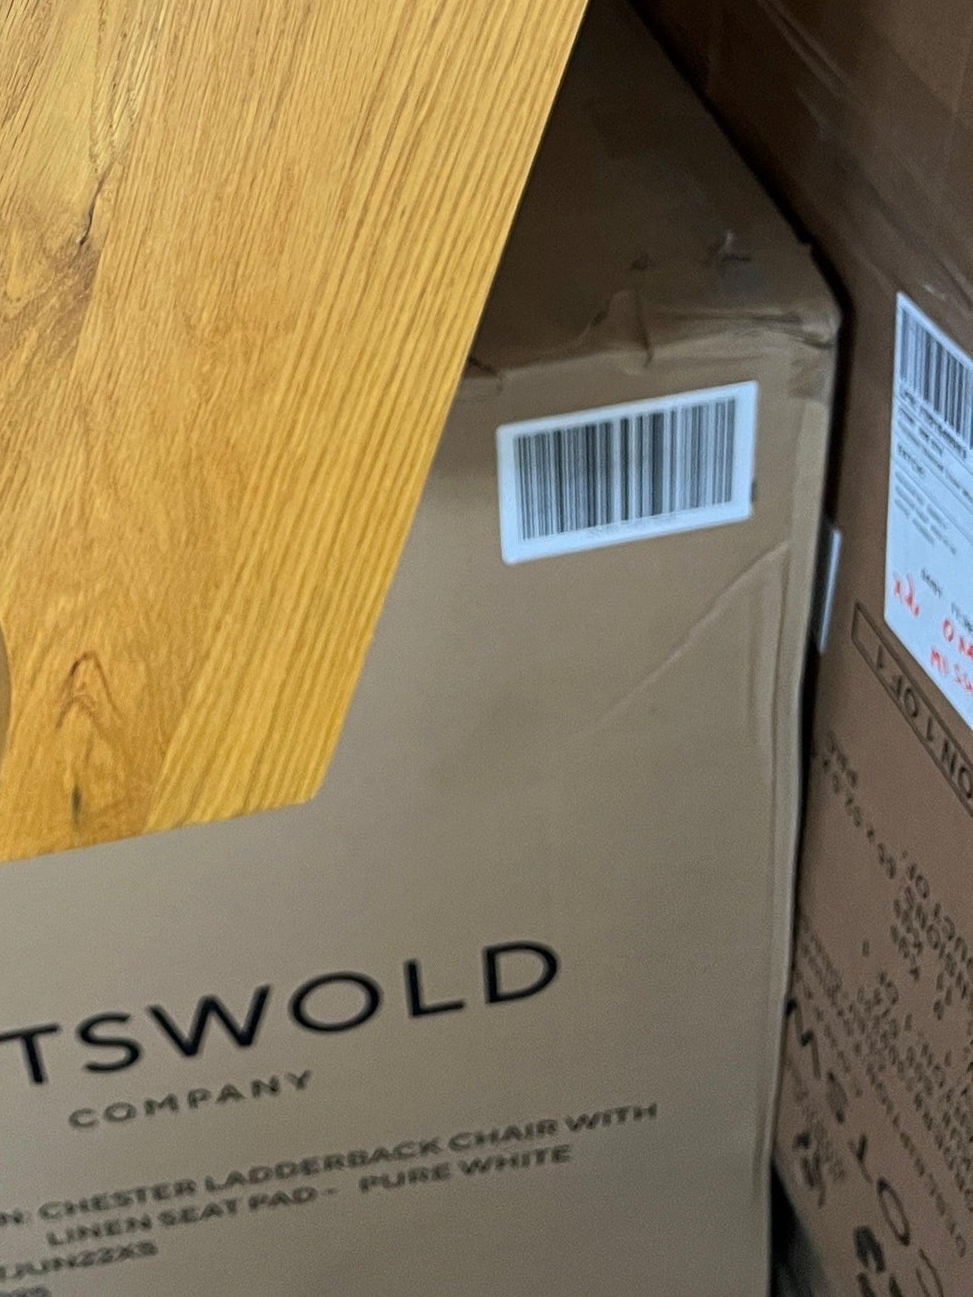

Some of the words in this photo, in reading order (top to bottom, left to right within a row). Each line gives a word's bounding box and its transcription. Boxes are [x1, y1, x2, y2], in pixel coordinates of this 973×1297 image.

[68, 1068, 313, 1130] COMPANY
[38, 1177, 198, 1221] CHESTER
[205, 1136, 441, 1193] LADDERBACK
[447, 1118, 558, 1153] CHAIR
[564, 1102, 659, 1134] WITH
[45, 1213, 153, 1248] LINEN
[158, 1199, 239, 1228] SEAT
[246, 1185, 317, 1213] PAD
[358, 1160, 453, 1195] PURE
[456, 1143, 575, 1177] WHITE
